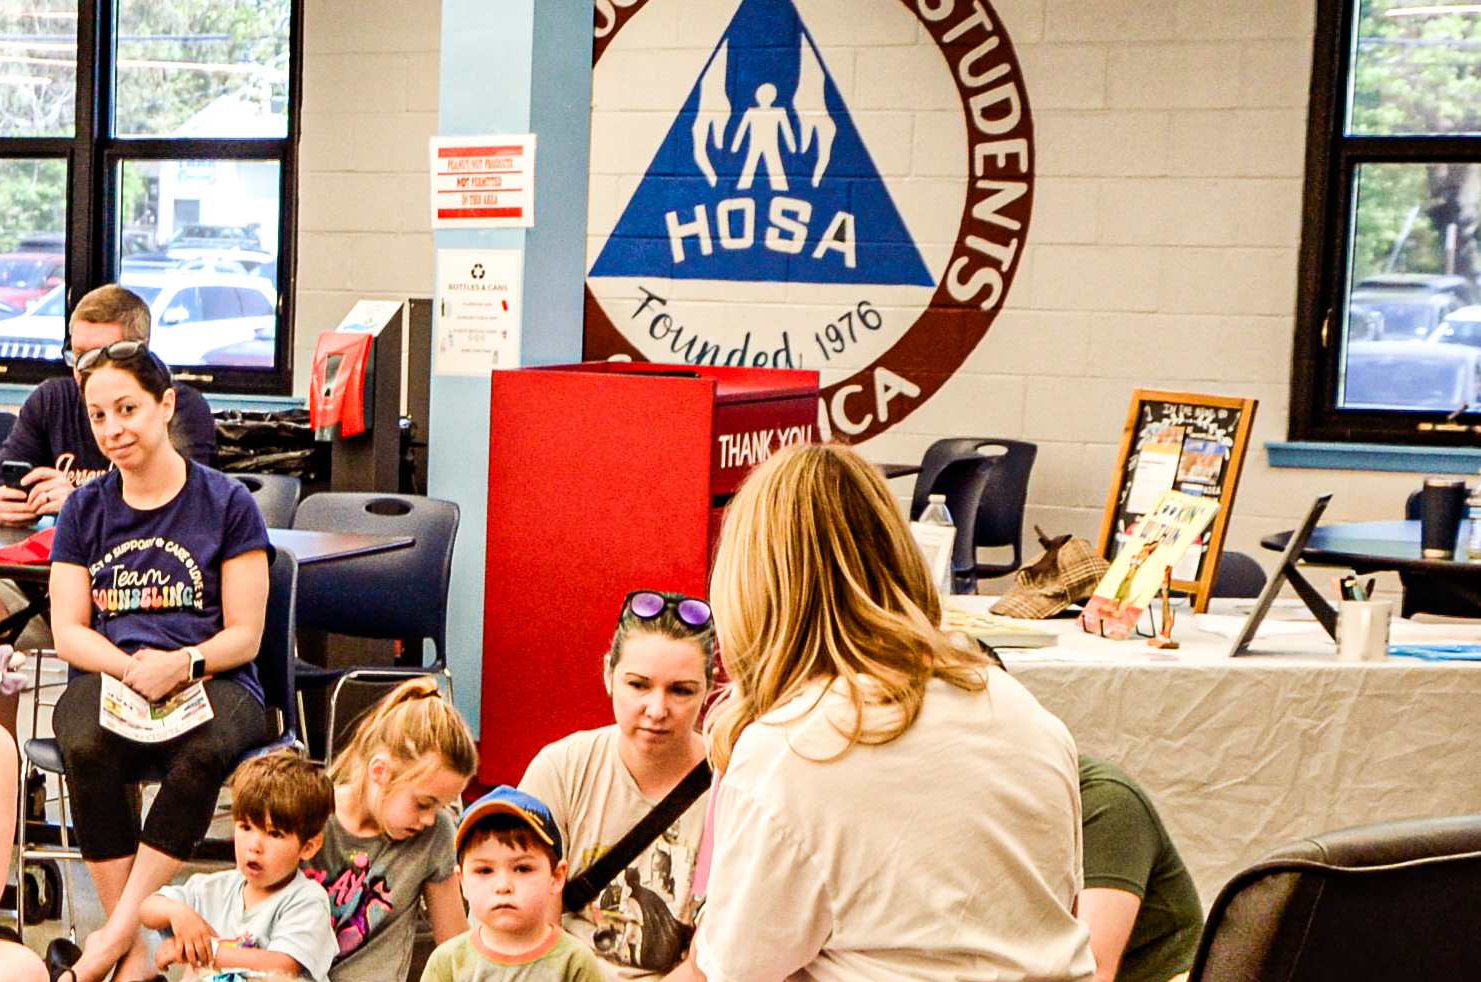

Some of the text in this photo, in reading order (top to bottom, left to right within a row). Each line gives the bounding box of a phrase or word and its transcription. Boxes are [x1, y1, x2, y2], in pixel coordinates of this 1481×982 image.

[665, 196, 856, 268] HOSA
[448, 283, 479, 291] BOTTLES
[488, 284, 508, 292] CANS
[627, 286, 883, 367] Founded 1976
[718, 424, 813, 469] THANK YOU
[112, 564, 171, 589] Team
[164, 540, 191, 565] CARE
[188, 566, 204, 592] LOVE
[93, 582, 194, 611] COUNSELING
